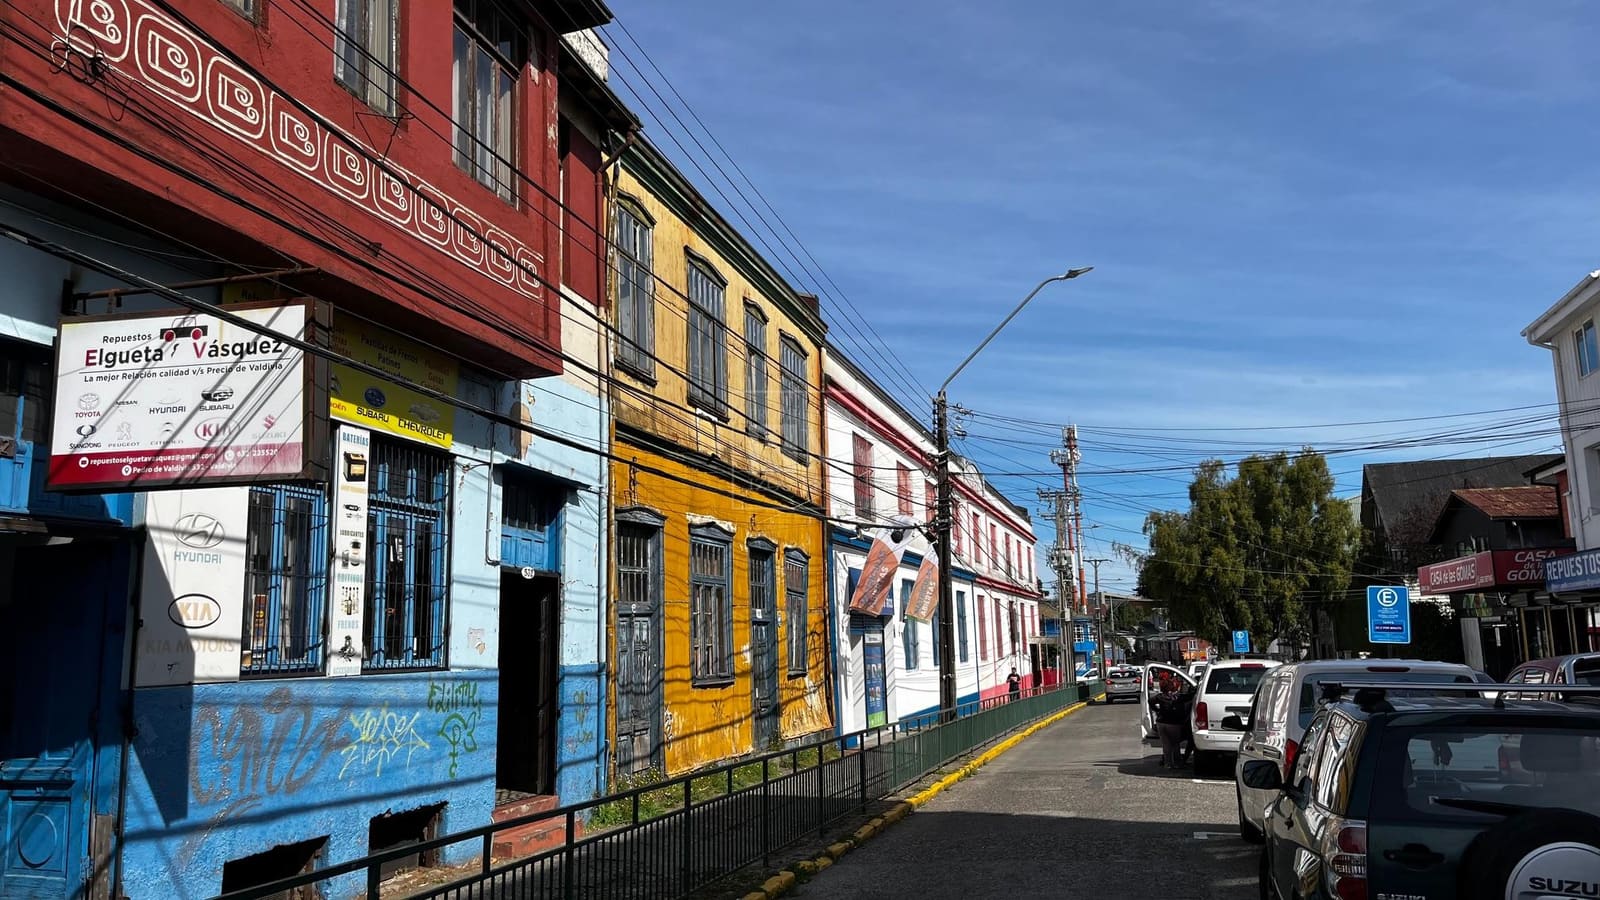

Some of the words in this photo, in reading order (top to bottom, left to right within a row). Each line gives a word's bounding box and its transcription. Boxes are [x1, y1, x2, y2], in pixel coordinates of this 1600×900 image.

[102, 333, 152, 344] Repuestos
[85, 346, 164, 368] Elgueta
[192, 339, 282, 359] Vásquez
[96, 374, 119, 382] mejor
[121, 371, 156, 380] Relación
[159, 368, 190, 378] calidad
[192, 367, 204, 376] v/s
[206, 366, 233, 374] Precio
[236, 365, 246, 373] de
[249, 362, 283, 371] Valdivia
[149, 405, 186, 415] HYUNDAI
[356, 406, 390, 423] SUBARU
[398, 418, 447, 440] CHEVROLET
[342, 432, 369, 447] BATERÍAS
[132, 466, 153, 474] Pedro
[153, 465, 162, 473] de
[174, 551, 222, 564] HYUNDAI
[1514, 550, 1556, 562] CASA
[1546, 552, 1600, 581] REPUESTOS
[1430, 570, 1443, 585] CASA
[1456, 563, 1475, 582] GOMAS
[1507, 569, 1545, 581] GOM
[1382, 591, 1392, 604] E
[178, 602, 213, 621] KIA
[146, 640, 171, 653] KIA
[175, 639, 235, 653] MOTORS
[1529, 877, 1600, 896] SUZU
